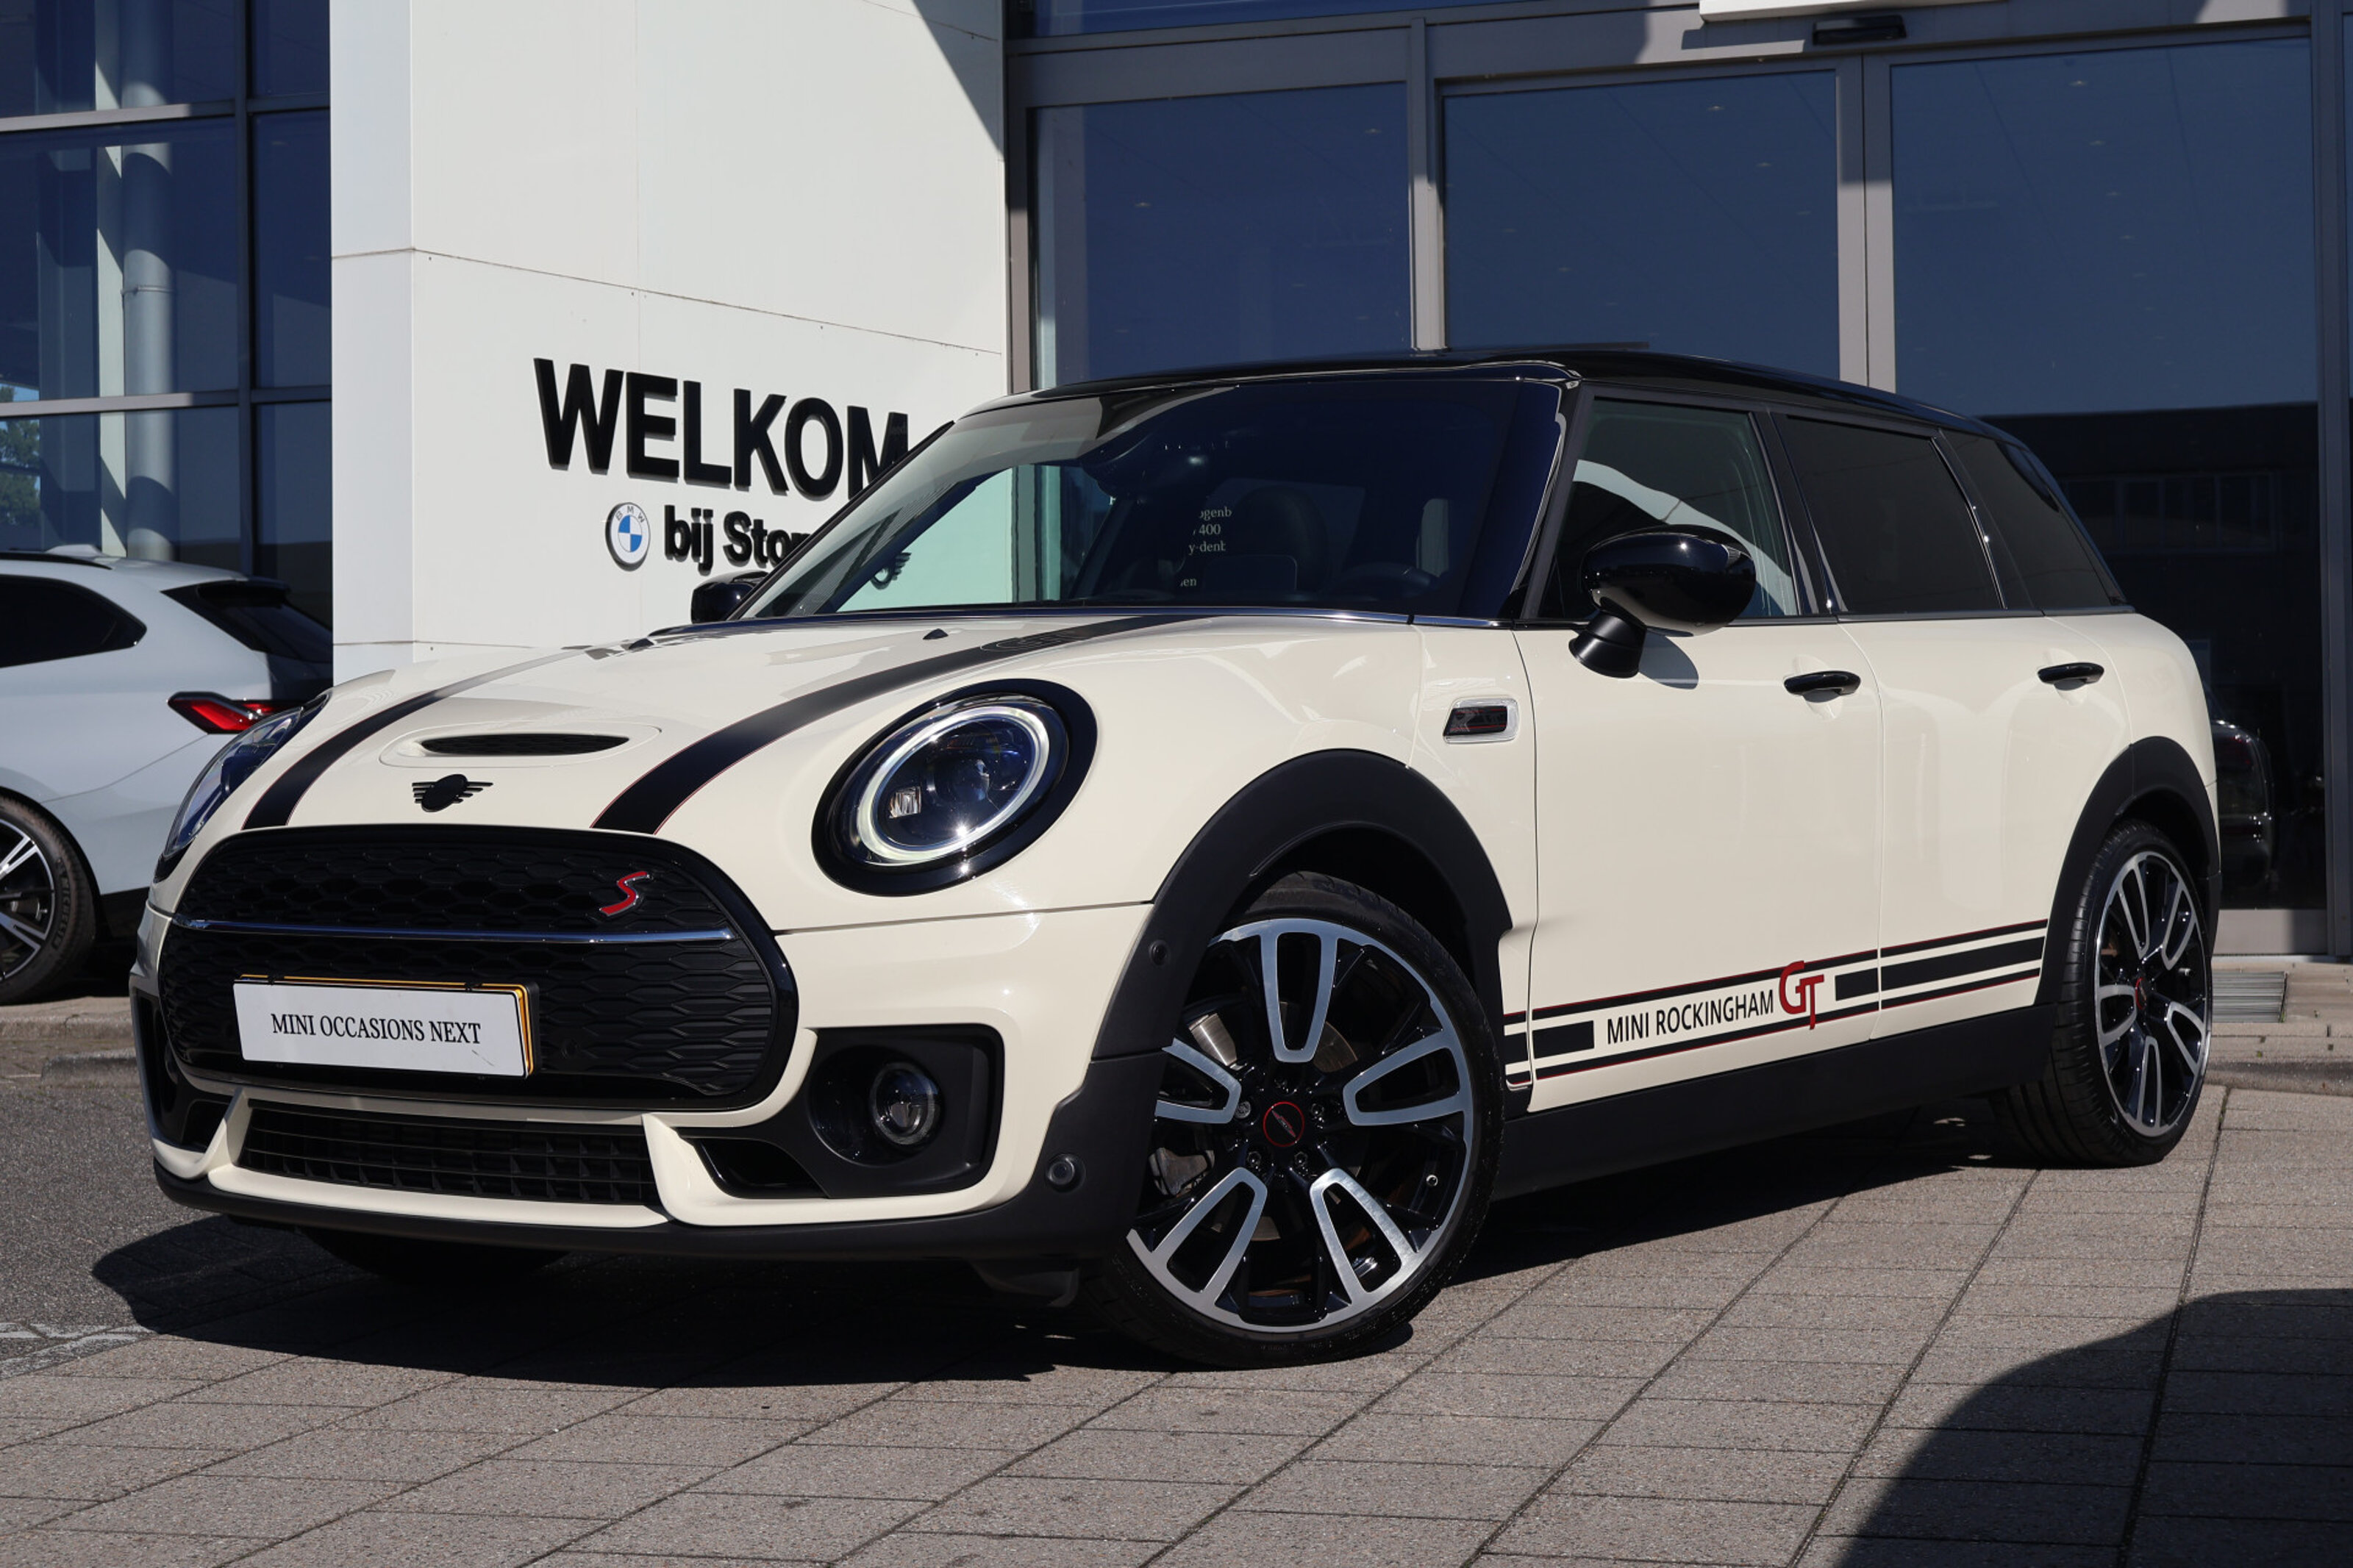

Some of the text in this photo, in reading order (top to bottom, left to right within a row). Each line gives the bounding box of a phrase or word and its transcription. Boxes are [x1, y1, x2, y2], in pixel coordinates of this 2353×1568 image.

[533, 357, 908, 501] WELKOM
[615, 505, 645, 523] BMW
[1199, 523, 1221, 536] 400
[664, 504, 713, 576] bij
[599, 870, 650, 917] S
[1607, 960, 1824, 1045] MINI ROCKINGHAM GT
[271, 1013, 481, 1044] MINI OCCASIONS NEXT
